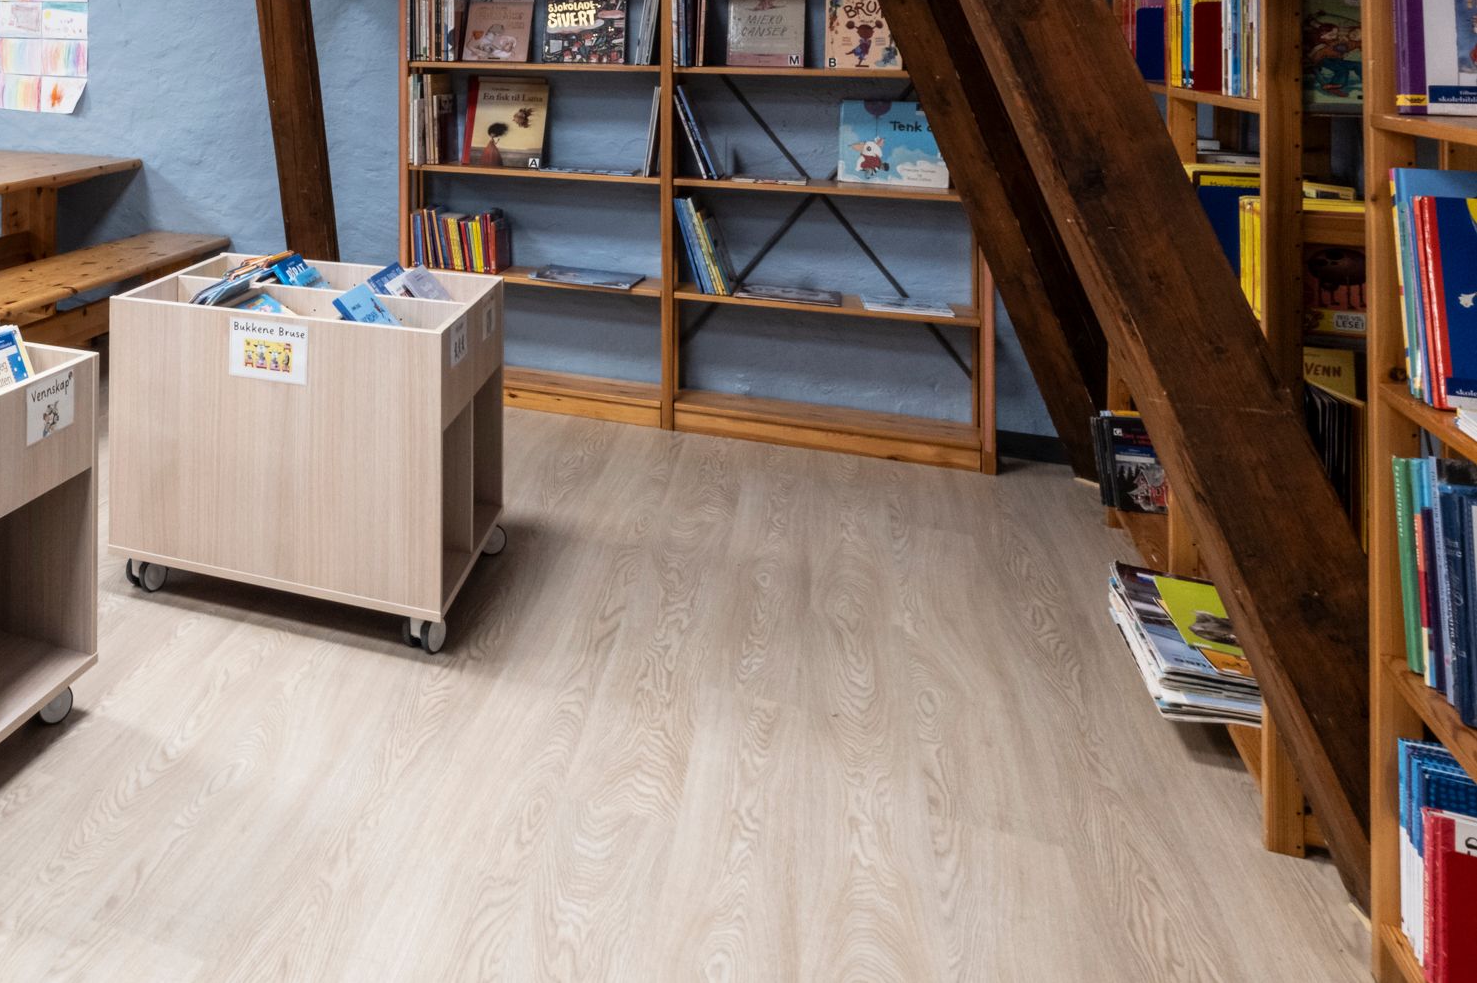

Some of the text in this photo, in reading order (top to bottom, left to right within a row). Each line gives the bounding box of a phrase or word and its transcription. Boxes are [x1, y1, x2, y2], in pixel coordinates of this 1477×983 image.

[547, 9, 596, 28] SIVERT
[789, 55, 799, 65] M
[828, 57, 837, 67] B
[496, 93, 509, 101] fisk
[890, 121, 922, 132] Tenk
[530, 158, 538, 167] A
[233, 321, 305, 338] Bukkene Bruse
[1304, 362, 1342, 378] VENN
[31, 377, 71, 403] Vennskap
